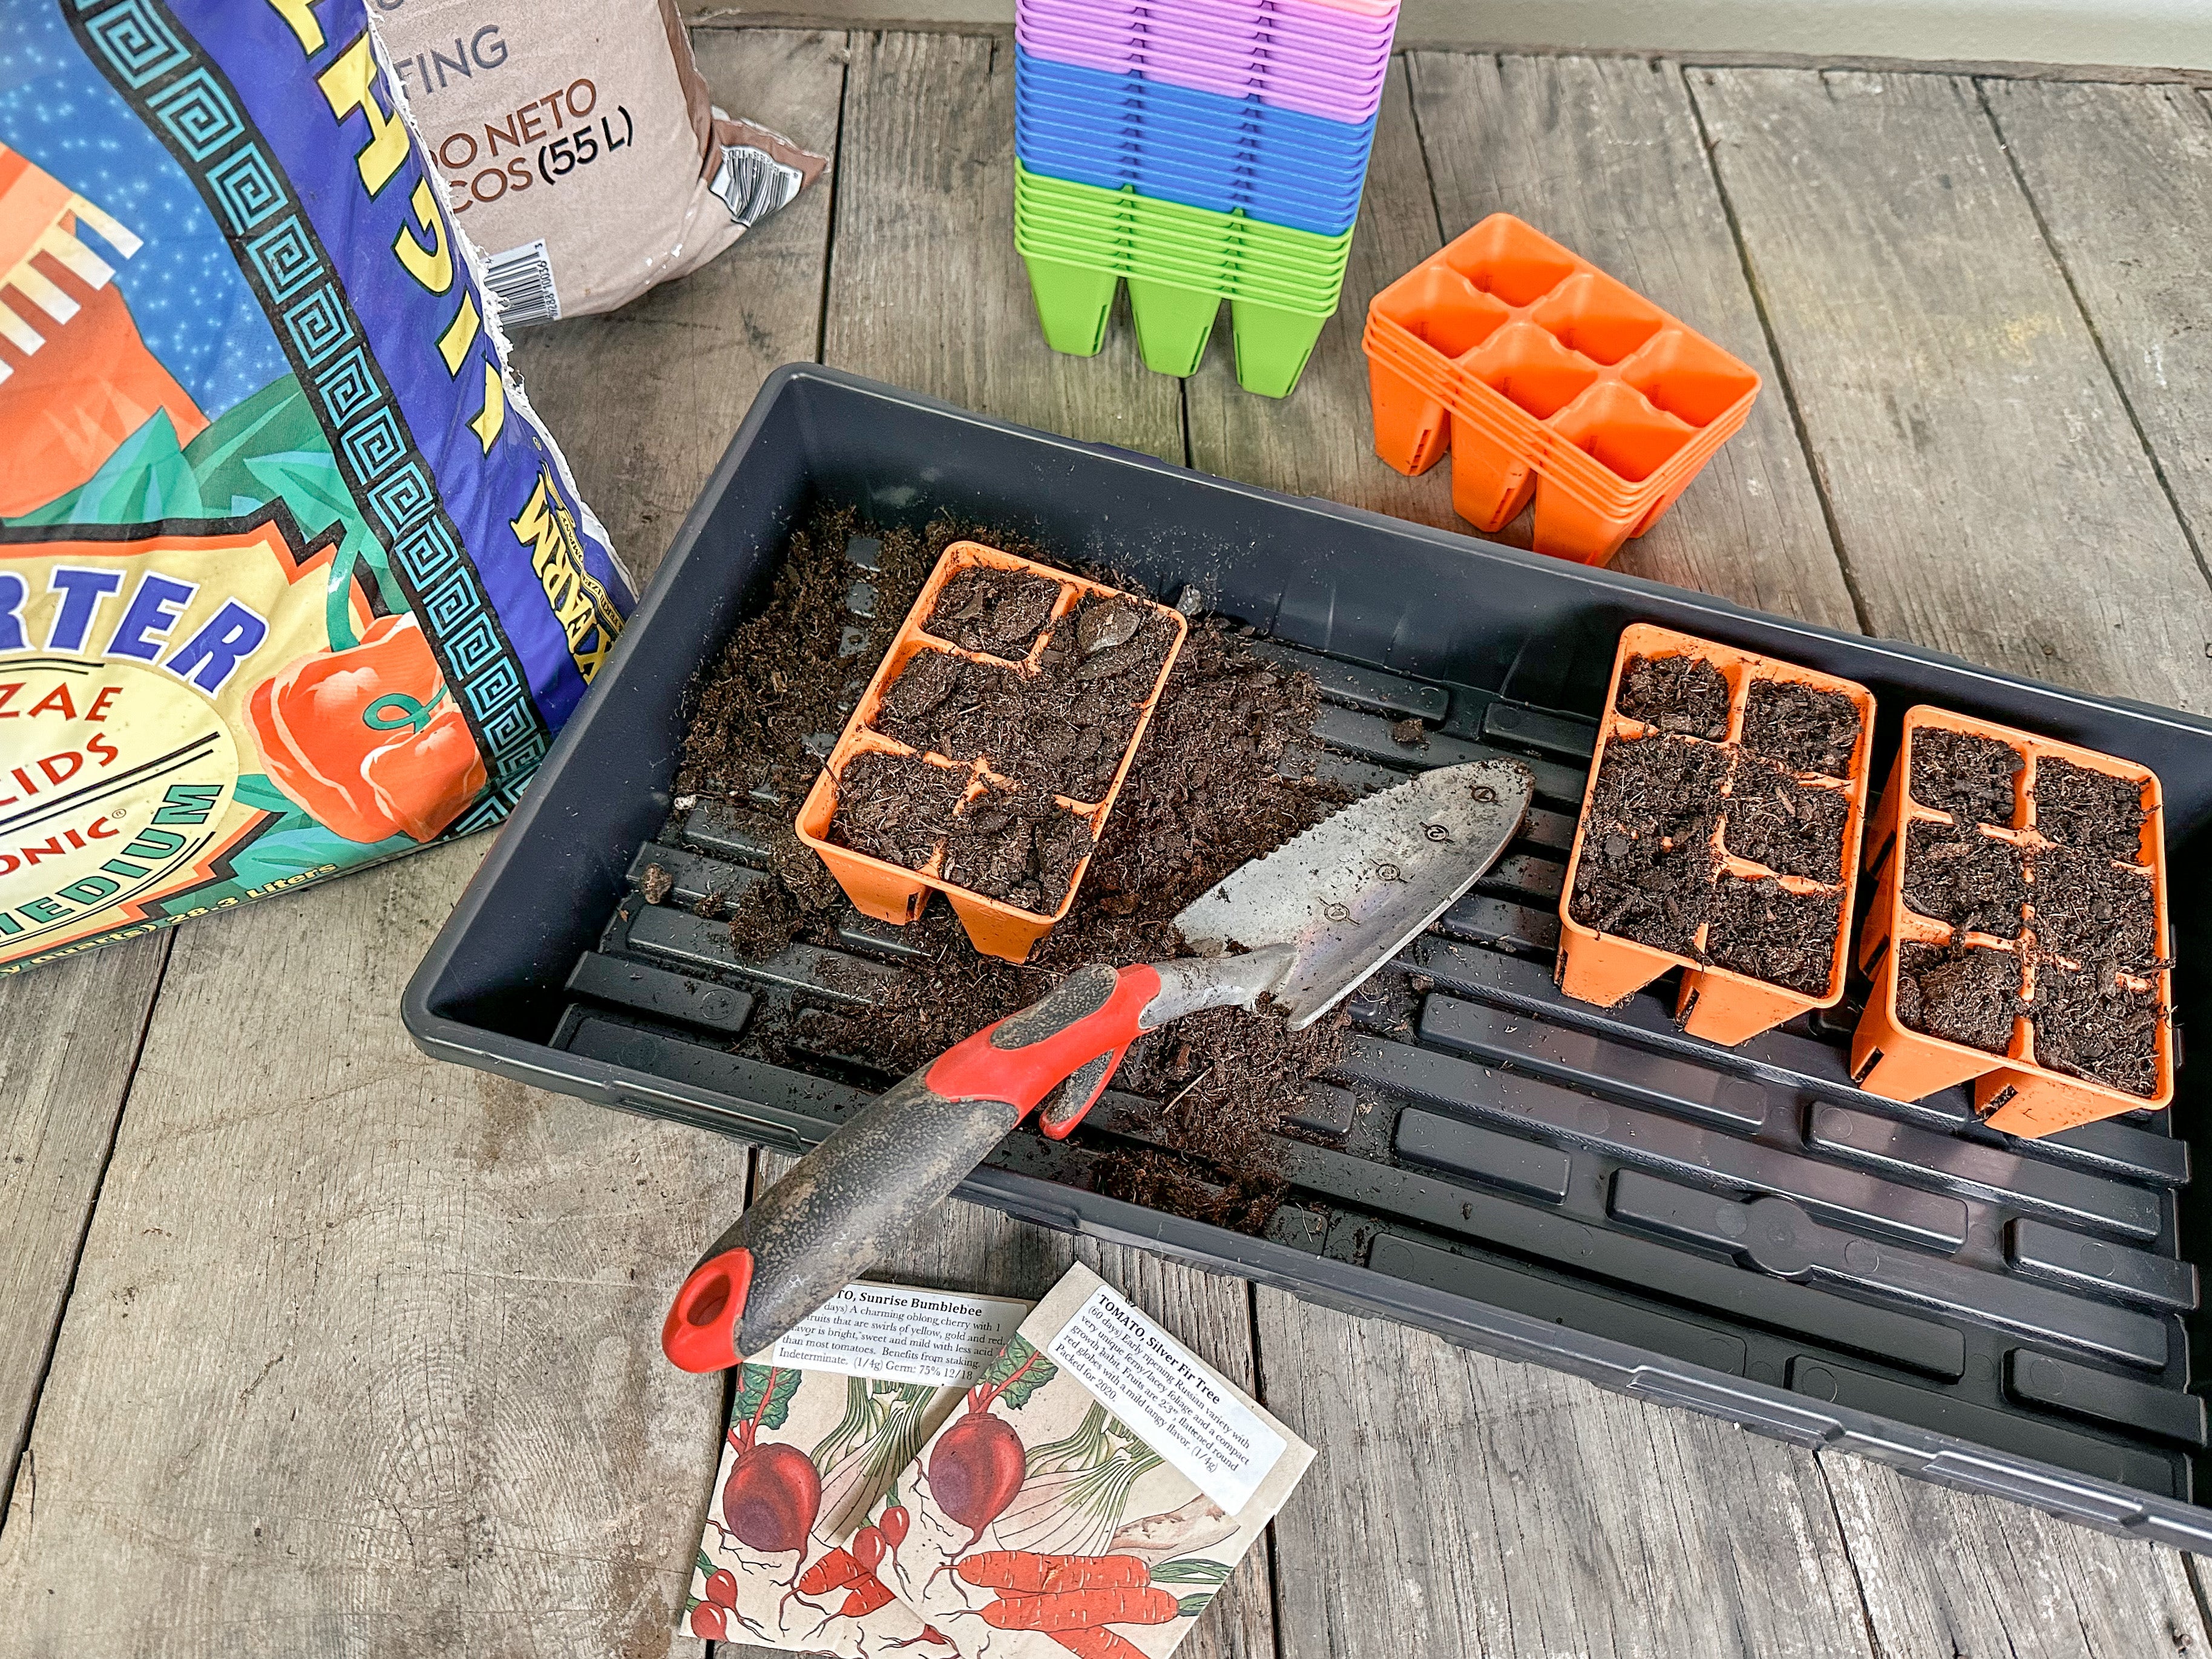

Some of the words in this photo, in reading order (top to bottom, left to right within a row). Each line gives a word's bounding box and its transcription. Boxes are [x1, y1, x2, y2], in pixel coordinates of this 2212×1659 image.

[484, 78, 597, 157] NETO
[538, 125, 598, 186] (55
[601, 105, 634, 153] L)
[166, 896, 240, 925] 28.3
[245, 862, 338, 899] Liters
[824, 1301, 847, 1314] days)
[849, 1305, 857, 1313] A
[860, 1307, 905, 1321] charming
[907, 1312, 939, 1326] oblong
[940, 1316, 971, 1330] cherry
[972, 1319, 992, 1333] with
[833, 1315, 852, 1326] that
[870, 1321, 896, 1332] swirls
[899, 1324, 911, 1335] of
[910, 1326, 942, 1339] yellow,
[944, 1331, 966, 1341] gold
[967, 1332, 986, 1343] and
[859, 1292, 907, 1306] Sunrise
[910, 1298, 983, 1316] Bumblebee
[779, 1347, 848, 1364] Indeterminate.
[854, 1356, 882, 1371] (1/4g)
[919, 1365, 940, 1376] 75%
[944, 1367, 973, 1381] 12/18
[782, 1335, 803, 1345] than
[805, 1340, 829, 1349] most
[832, 1342, 876, 1354] tomatoes.
[882, 1346, 918, 1359] Benefits
[921, 1352, 943, 1363] from
[945, 1356, 980, 1369] staking.
[818, 1326, 825, 1335] is
[827, 1327, 858, 1341] bright,
[861, 1334, 887, 1342] sweet
[888, 1336, 907, 1345] and
[909, 1338, 930, 1348] mild
[933, 1341, 952, 1351] with
[955, 1343, 971, 1354] less
[973, 1344, 994, 1358] acid
[1054, 1342, 1085, 1372] Packed
[1082, 1368, 1095, 1381] for
[1095, 1379, 1116, 1402] 2020.
[1099, 1295, 1144, 1341] TOMATO,
[1146, 1336, 1178, 1365] Silver
[1177, 1362, 1195, 1380] Fir
[1195, 1377, 1219, 1404] Tree
[1063, 1335, 1080, 1349] red
[1075, 1347, 1102, 1370] globes
[1103, 1368, 1119, 1385] with
[1125, 1389, 1146, 1407] mild
[1144, 1405, 1167, 1427] tangy
[1166, 1424, 1190, 1449] flavor.
[1191, 1446, 1218, 1473] (1/4g)
[1070, 1326, 1098, 1350] growth
[1098, 1347, 1120, 1370] habit.
[1121, 1366, 1144, 1390] Fruits
[1144, 1388, 1158, 1401] are
[1178, 1417, 1214, 1450] flattened
[1212, 1448, 1239, 1471] round
[1081, 1315, 1098, 1332] very
[1098, 1331, 1124, 1355] unique
[1123, 1353, 1167, 1393] ferny/lacey
[1167, 1390, 1193, 1415] foliage
[1192, 1414, 1210, 1430] and
[1215, 1434, 1249, 1465] compact
[1088, 1306, 1103, 1319] (60
[1101, 1318, 1122, 1338] days)
[1120, 1333, 1143, 1355] Early
[1142, 1353, 1175, 1384] ripening
[1174, 1378, 1204, 1409] Russian
[1206, 1407, 1232, 1433] variety
[1232, 1431, 1249, 1448] with
